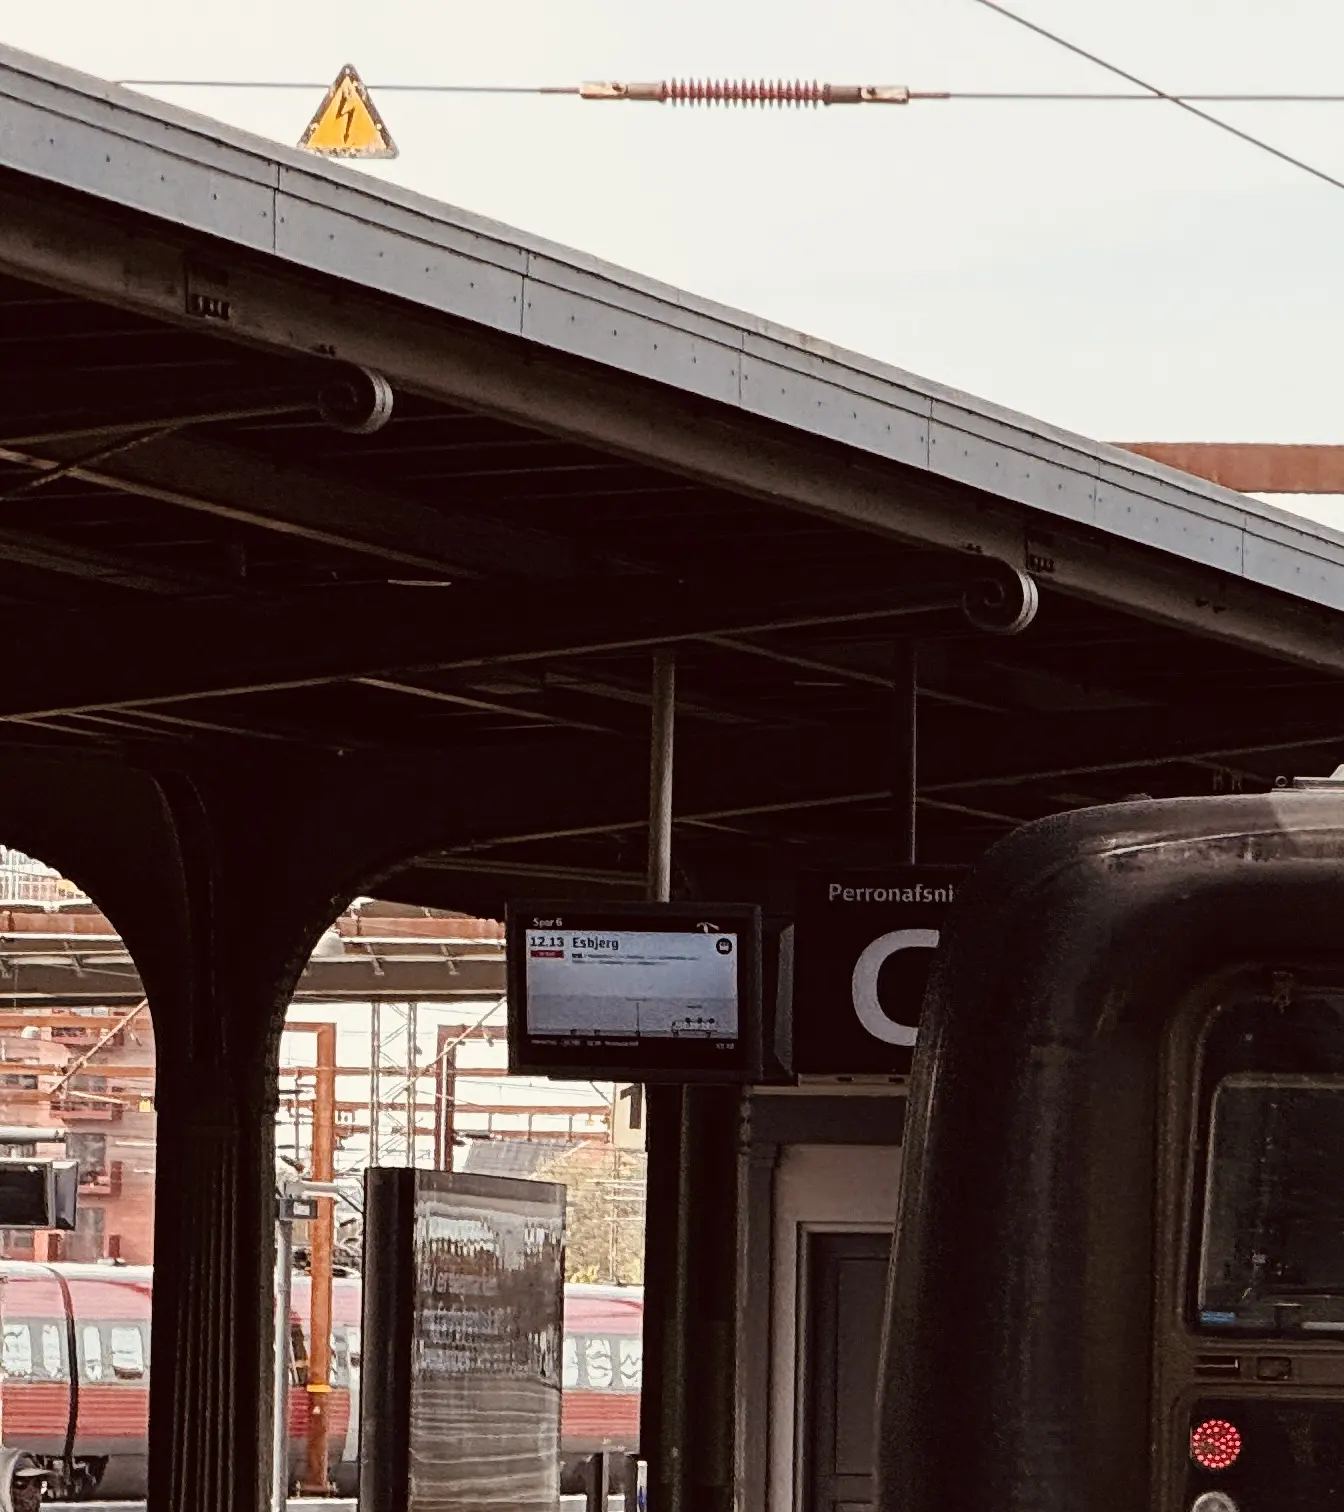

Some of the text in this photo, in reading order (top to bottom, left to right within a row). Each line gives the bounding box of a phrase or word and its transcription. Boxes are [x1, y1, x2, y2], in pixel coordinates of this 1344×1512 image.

[828, 883, 955, 902] Perronafsni
[530, 936, 565, 948] 12.13
[572, 936, 619, 950] Esbjerg
[852, 929, 940, 1047] C
